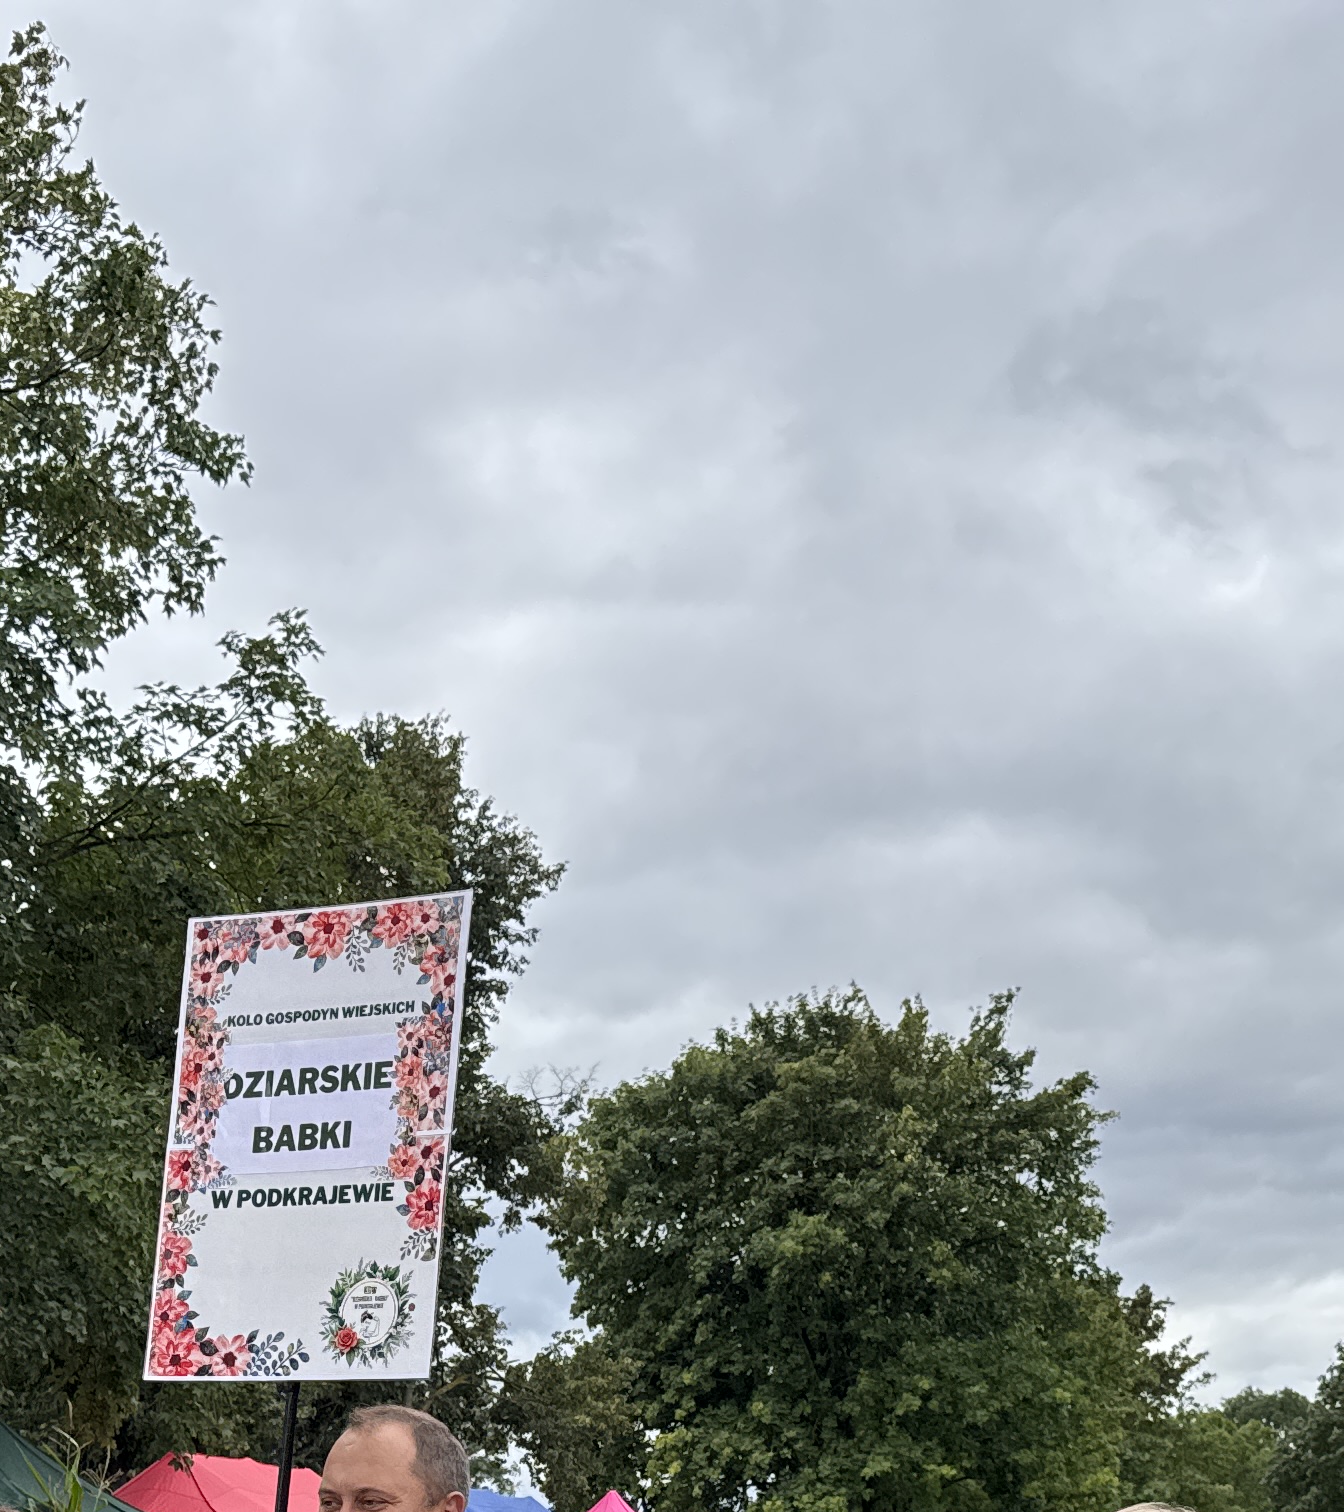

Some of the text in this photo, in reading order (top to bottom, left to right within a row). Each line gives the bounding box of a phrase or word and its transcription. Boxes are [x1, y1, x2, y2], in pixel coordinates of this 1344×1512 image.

[265, 1007, 340, 1026] GOSPODYN
[341, 1000, 416, 1019] WIEJSKICH
[251, 1120, 353, 1154] BABKI
[211, 1182, 395, 1210] W PODKRAJEWIE
